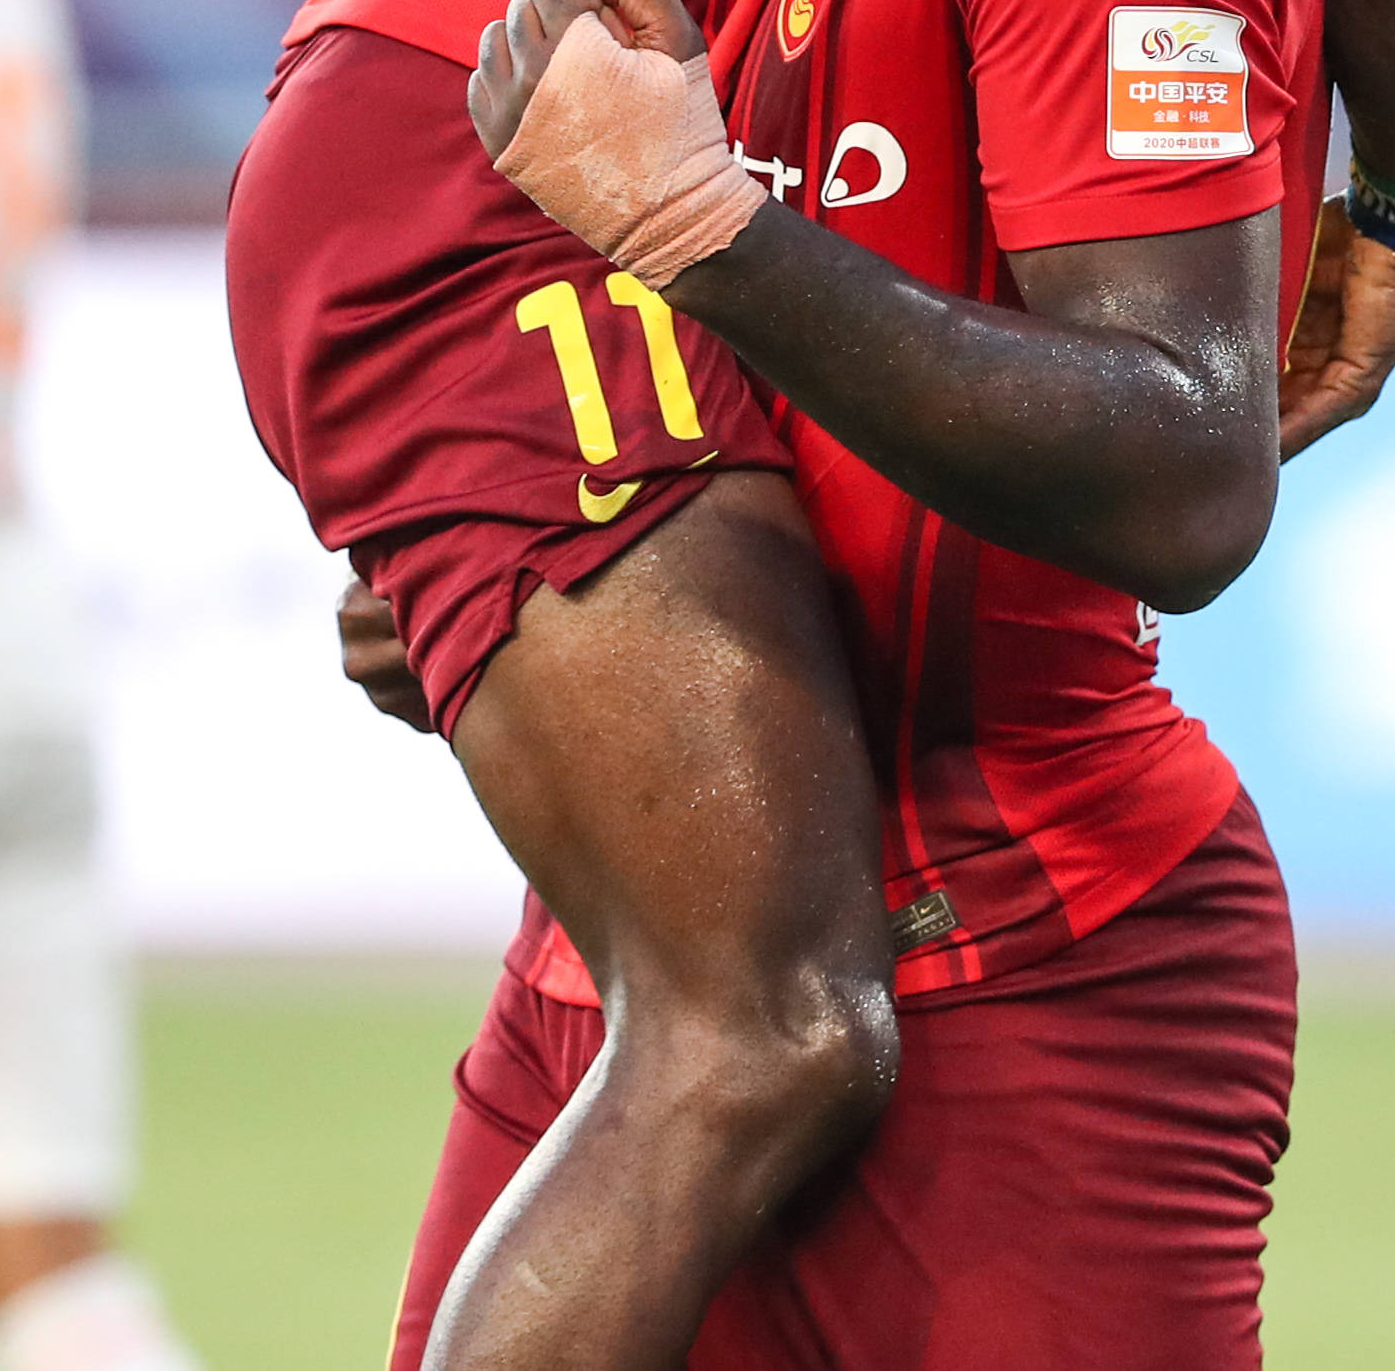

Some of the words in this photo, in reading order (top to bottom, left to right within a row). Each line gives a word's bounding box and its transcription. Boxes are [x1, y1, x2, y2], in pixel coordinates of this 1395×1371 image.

[1186, 49, 1220, 63] CSL
[1128, 80, 1229, 105] 中国平安
[1143, 137, 1221, 149] 2020中超联赛
[515, 270, 705, 465] 11
